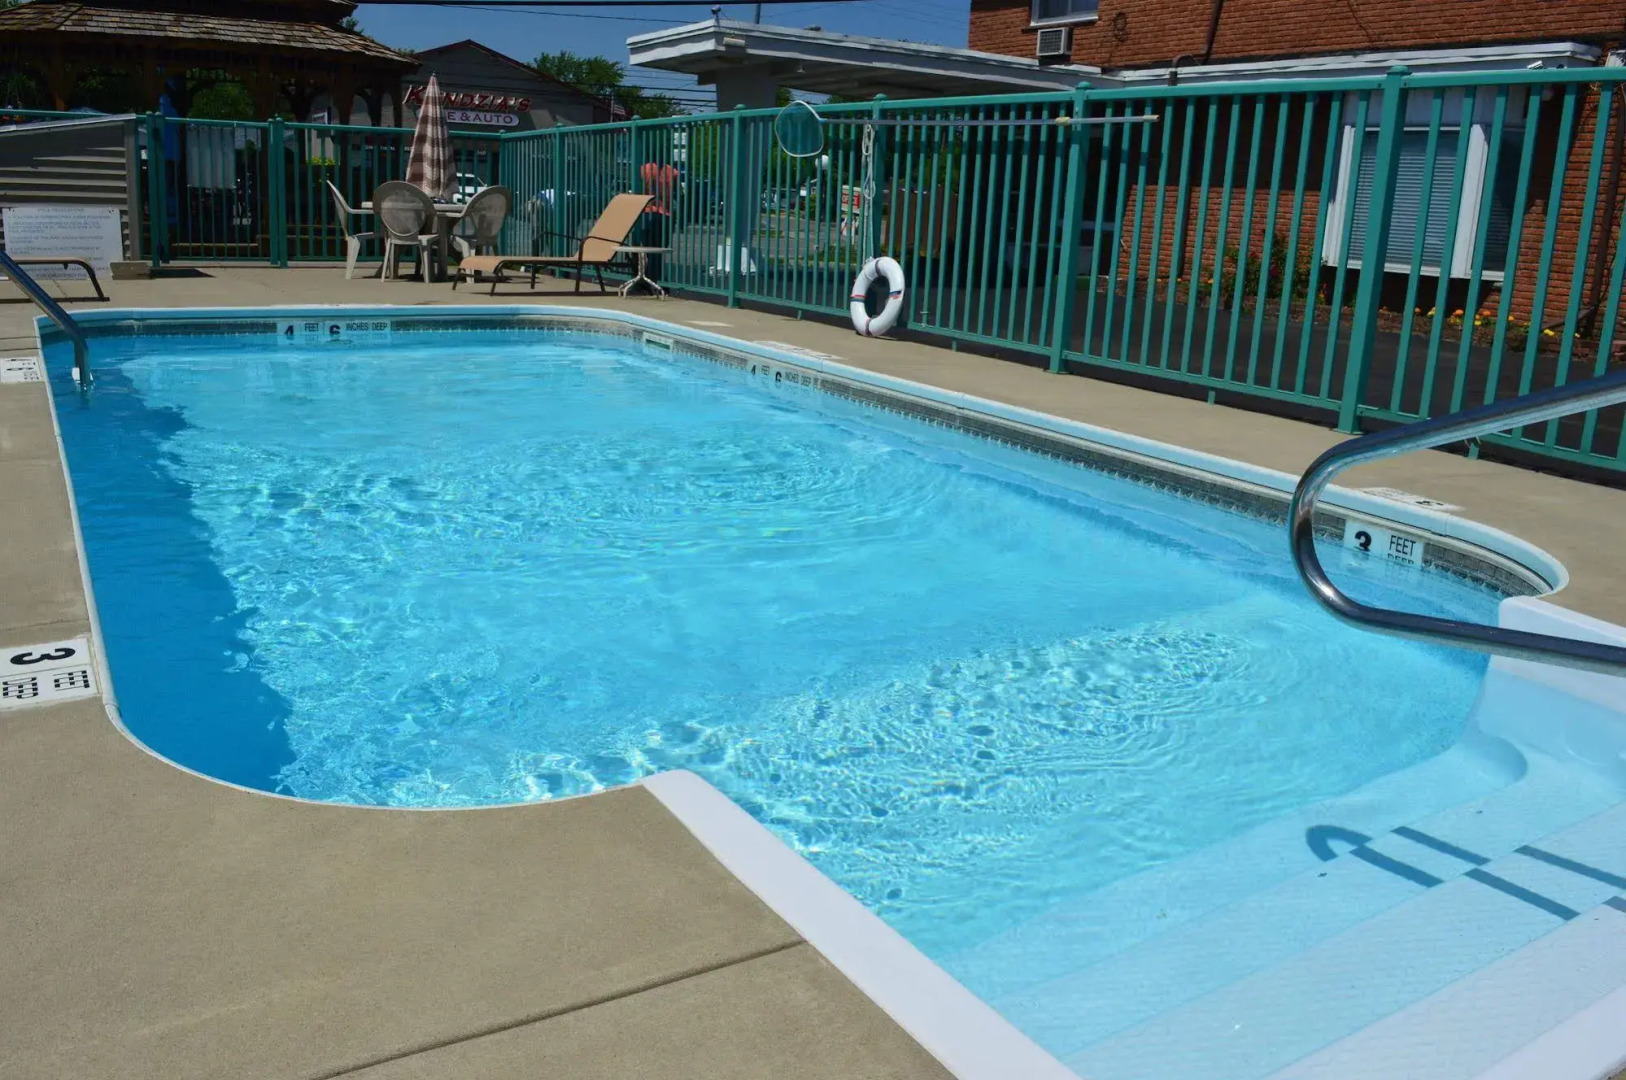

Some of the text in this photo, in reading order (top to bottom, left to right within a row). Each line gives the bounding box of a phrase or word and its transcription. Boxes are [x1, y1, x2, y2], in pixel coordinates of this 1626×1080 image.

[402, 85, 531, 112] KNDZIA'S
[304, 322, 319, 332] FEET
[345, 322, 368, 331] INCHES
[371, 322, 388, 331] DEEP
[1389, 534, 1416, 556] FEET
[10, 647, 76, 665] 3
[2, 677, 38, 699] DEEP
[53, 670, 90, 691] FEET
